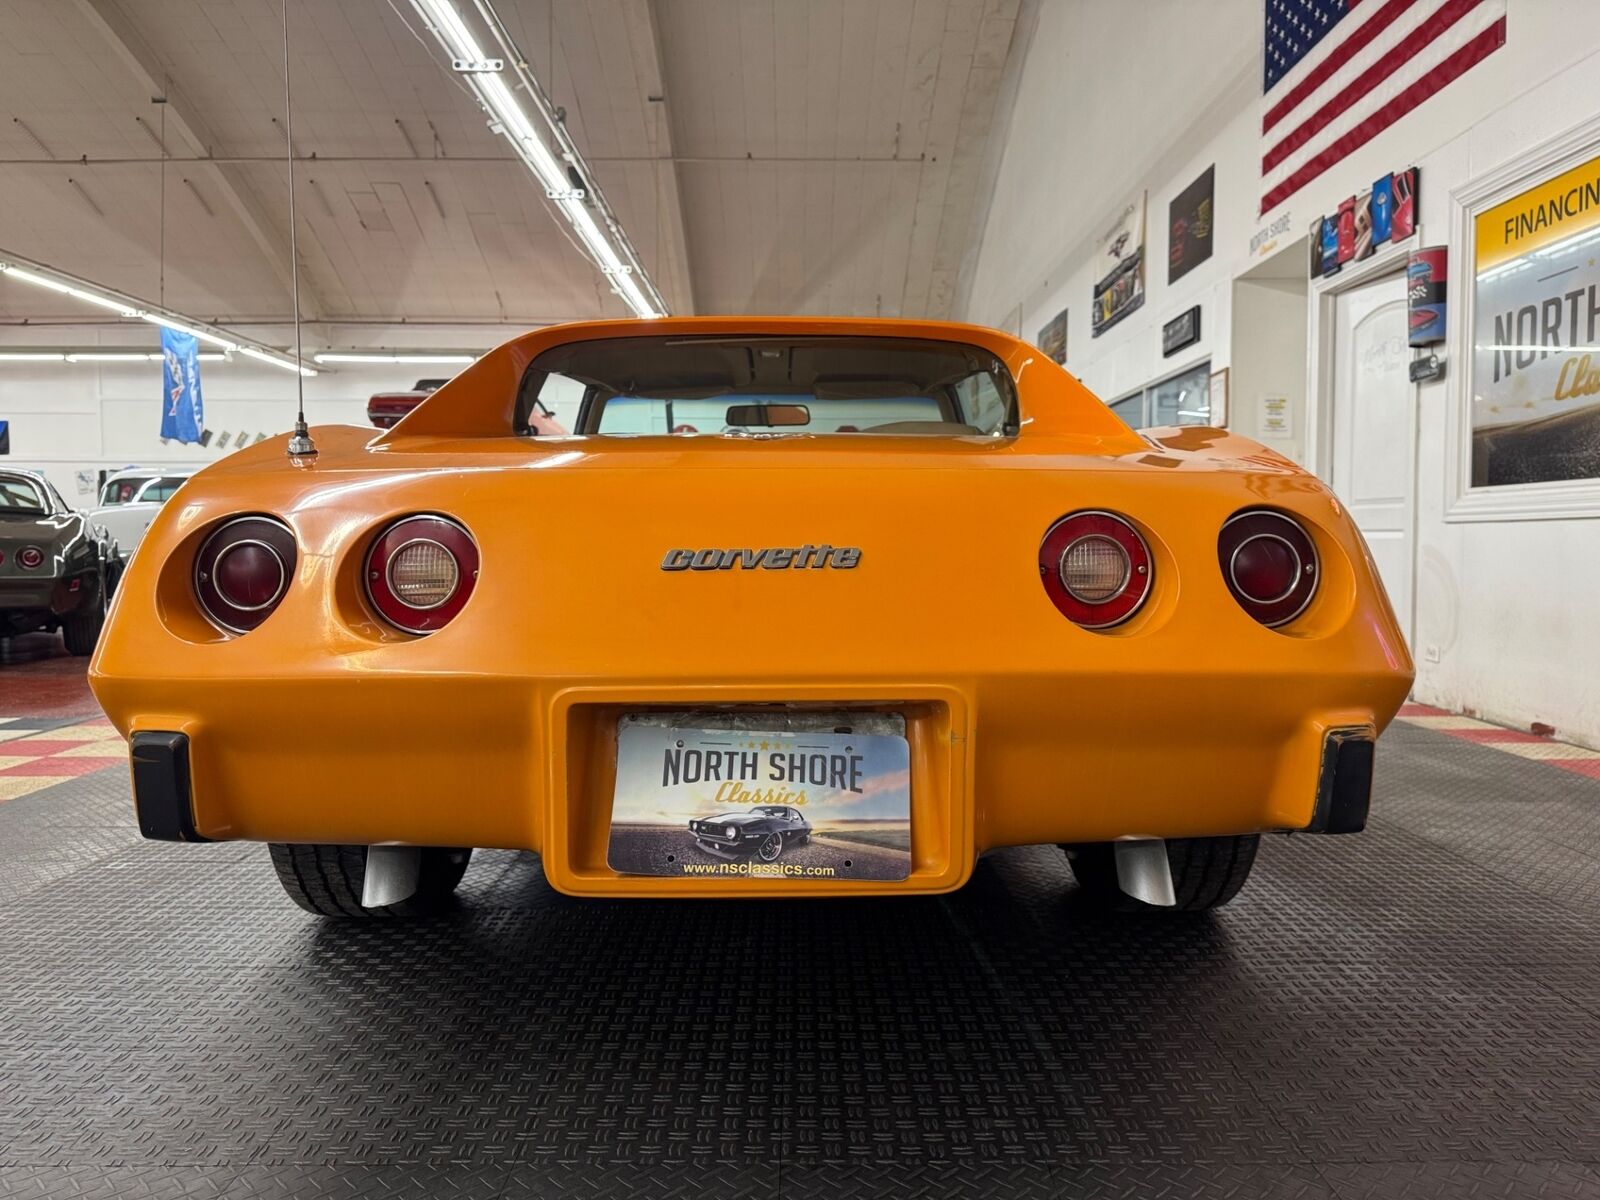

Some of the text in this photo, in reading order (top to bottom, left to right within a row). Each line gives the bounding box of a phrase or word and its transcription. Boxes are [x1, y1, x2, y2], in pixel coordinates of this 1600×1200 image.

[1504, 178, 1600, 245] FINANCIN
[1493, 284, 1600, 383] NORTH
[662, 748, 864, 794] NORTH SHORE
[714, 781, 809, 806] Classics
[683, 861, 835, 876] www.nsclassics.com
